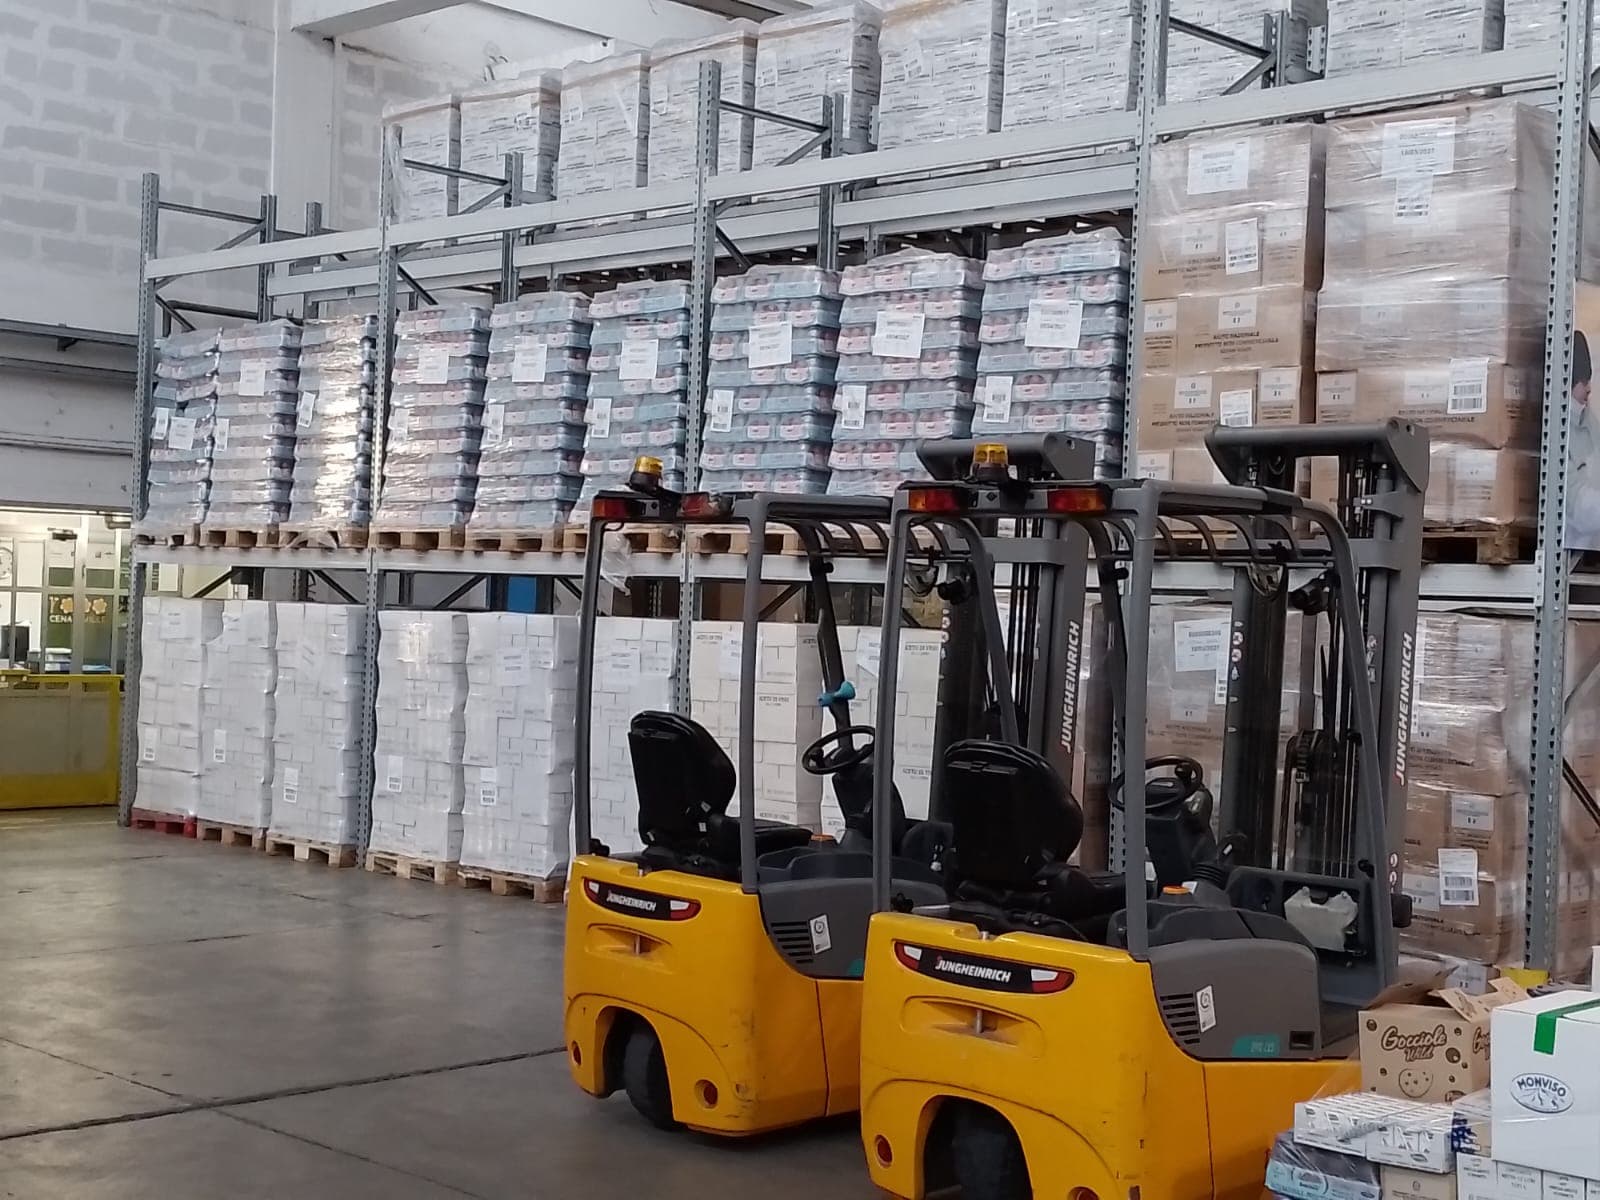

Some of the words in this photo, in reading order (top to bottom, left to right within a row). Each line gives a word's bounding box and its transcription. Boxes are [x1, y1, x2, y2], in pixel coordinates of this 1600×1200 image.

[49, 614, 73, 624] CENA
[1060, 620, 1080, 754] JUNGHEINRICH
[1394, 632, 1413, 787] JUNGHEINRICH
[606, 891, 658, 912] JUNGHEINRICH
[935, 956, 1012, 983] JUNGHEINRICH
[1381, 1024, 1448, 1051] Gocciole
[1404, 1046, 1434, 1063] Wild
[1516, 1076, 1567, 1097] MONVISO
